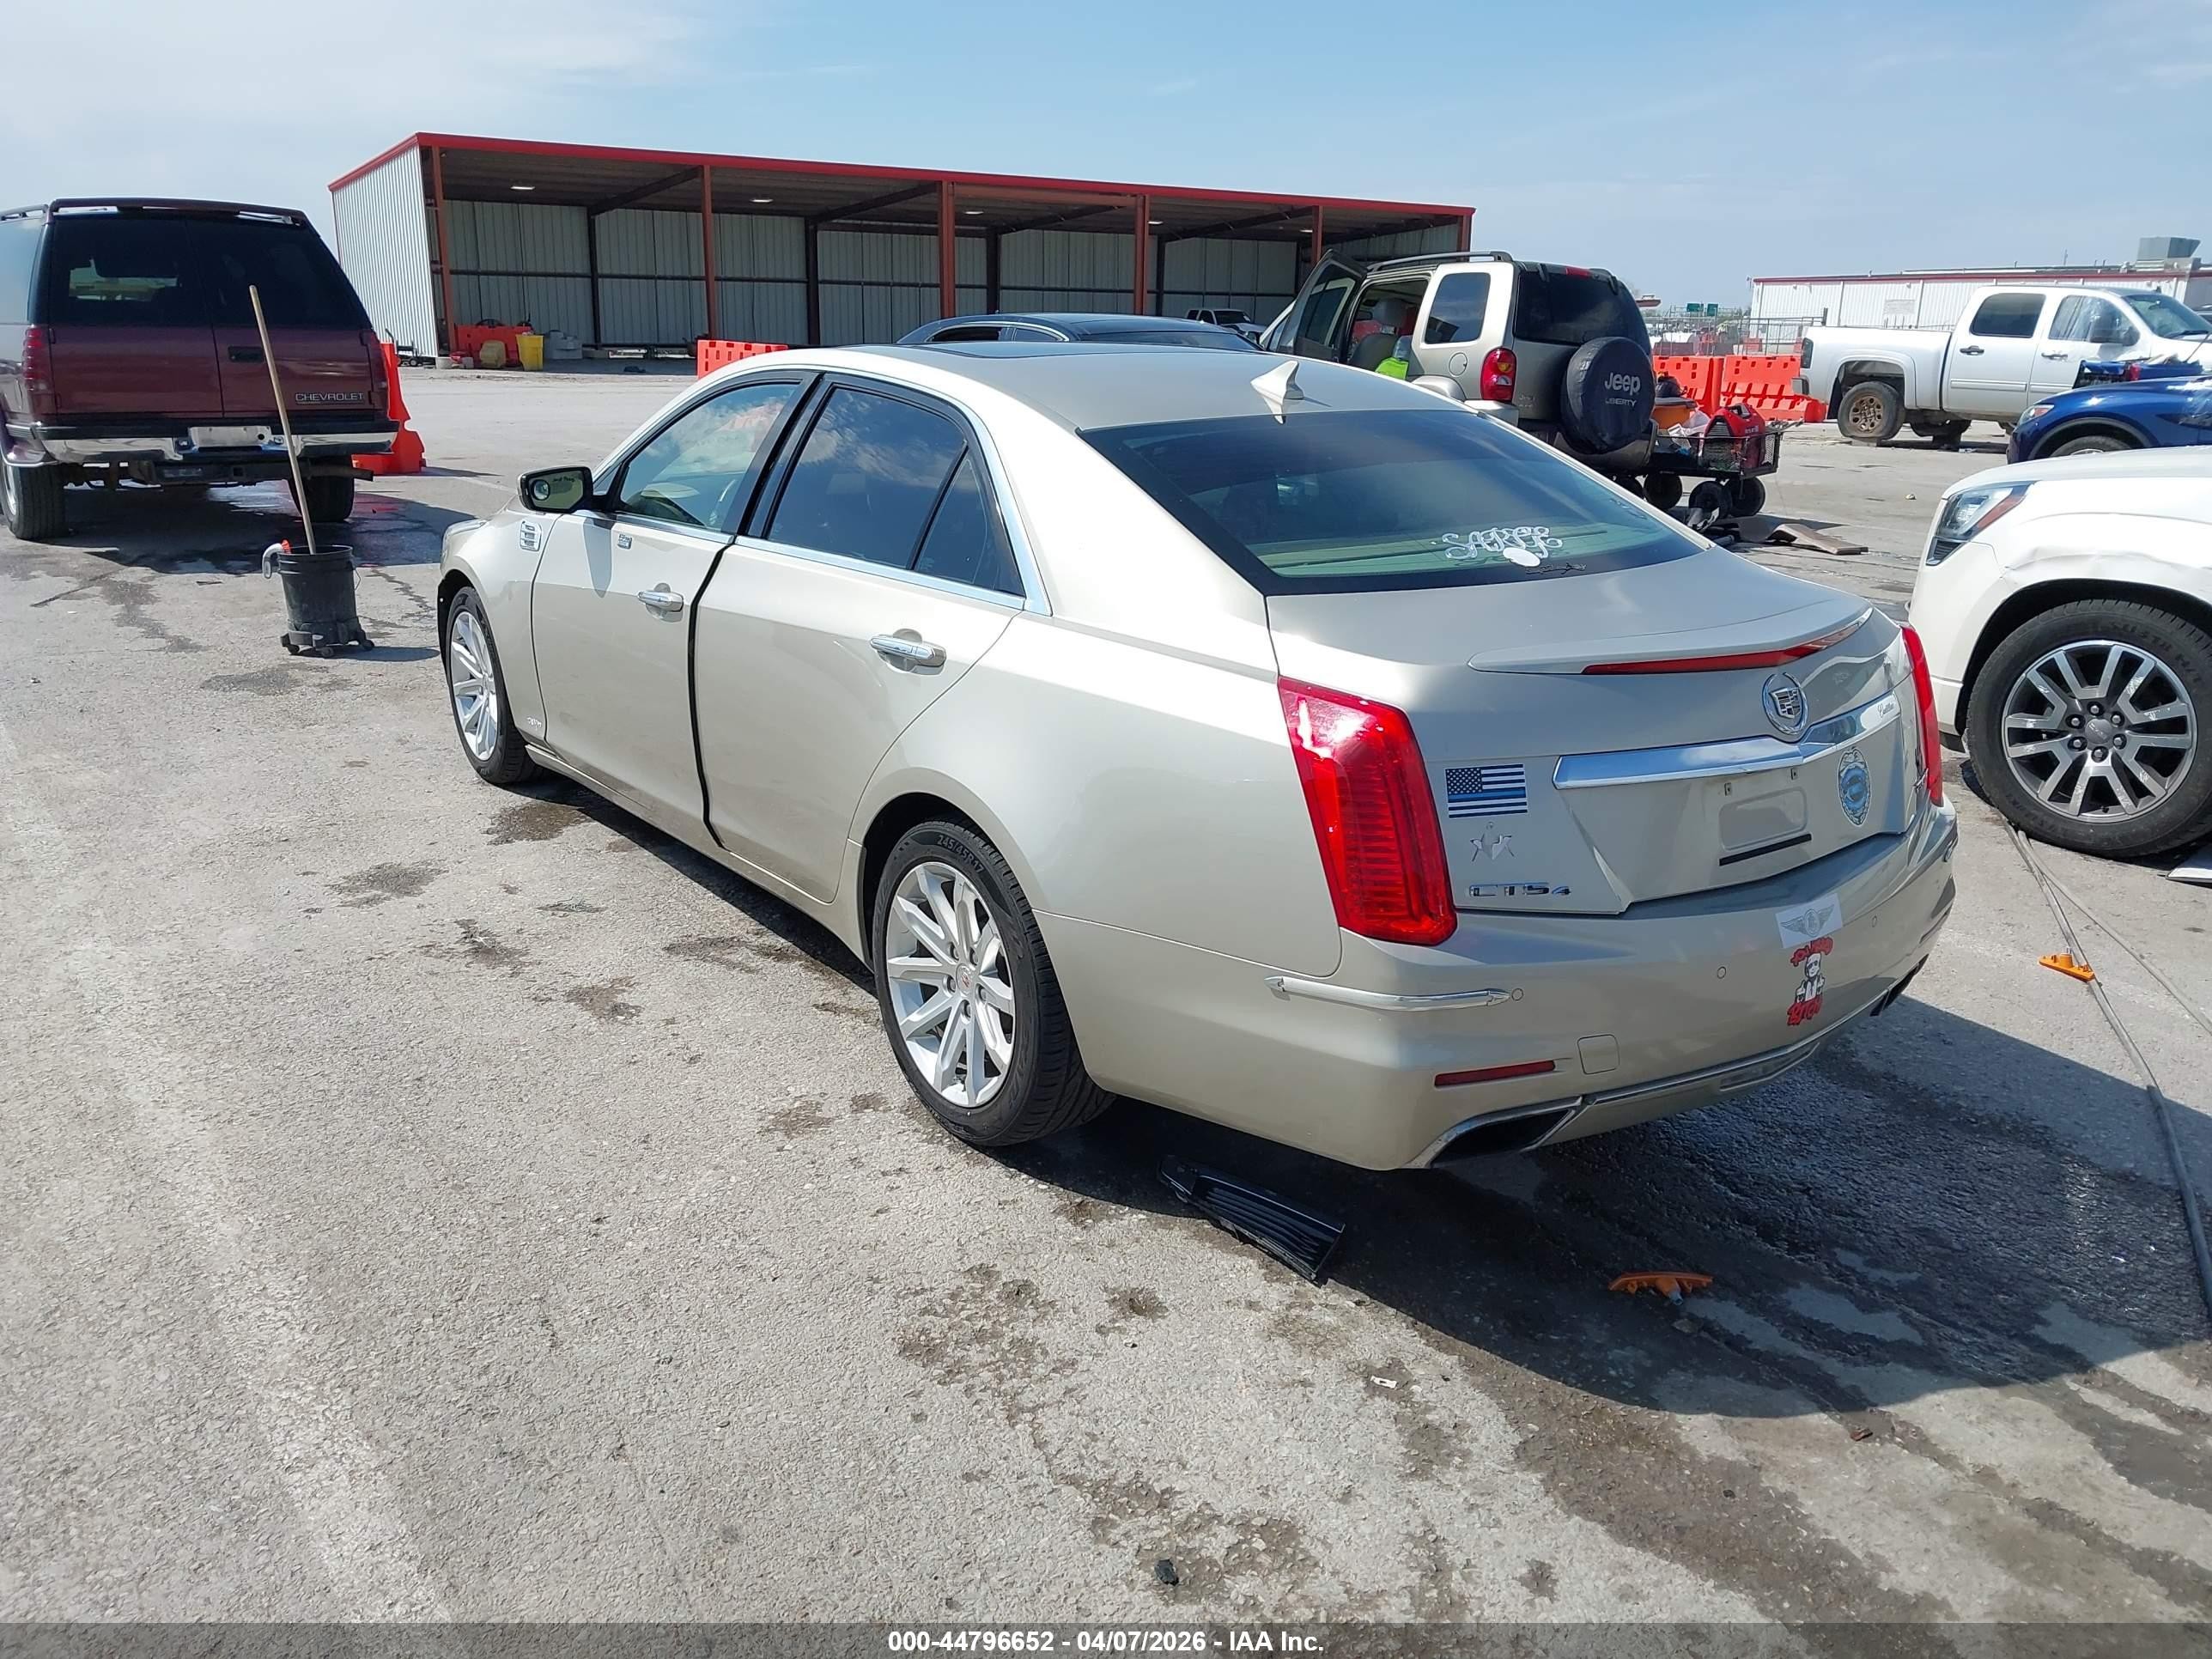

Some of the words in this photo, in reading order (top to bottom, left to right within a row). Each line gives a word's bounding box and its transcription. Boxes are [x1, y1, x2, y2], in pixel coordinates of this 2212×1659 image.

[1604, 372, 1641, 396] Jeep
[295, 392, 363, 401] CHEVROLET
[937, 834, 986, 873] 245/45R17
